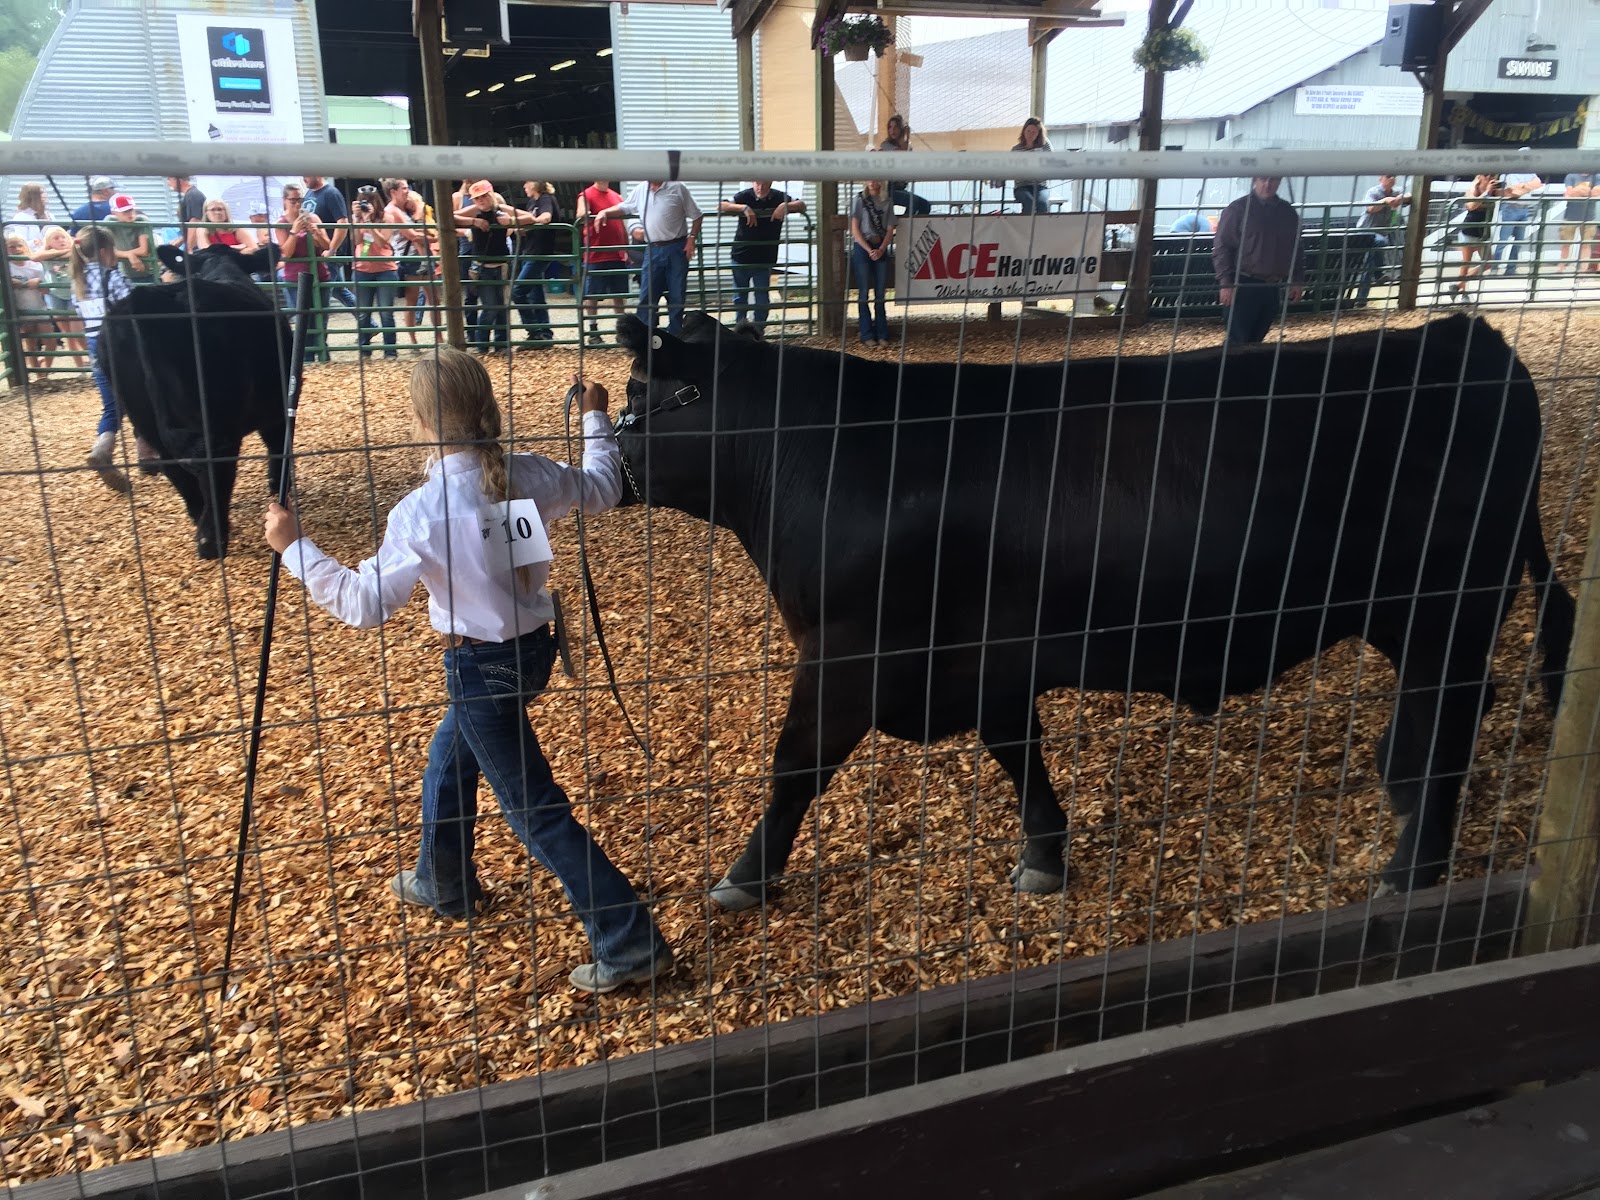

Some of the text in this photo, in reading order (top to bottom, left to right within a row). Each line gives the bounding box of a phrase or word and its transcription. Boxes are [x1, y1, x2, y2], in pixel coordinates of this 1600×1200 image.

[1505, 60, 1552, 77] SWINE
[914, 238, 1097, 280] ACE Hardware
[934, 280, 1063, 298] Welcome to the Fair!
[501, 517, 532, 543] 10
